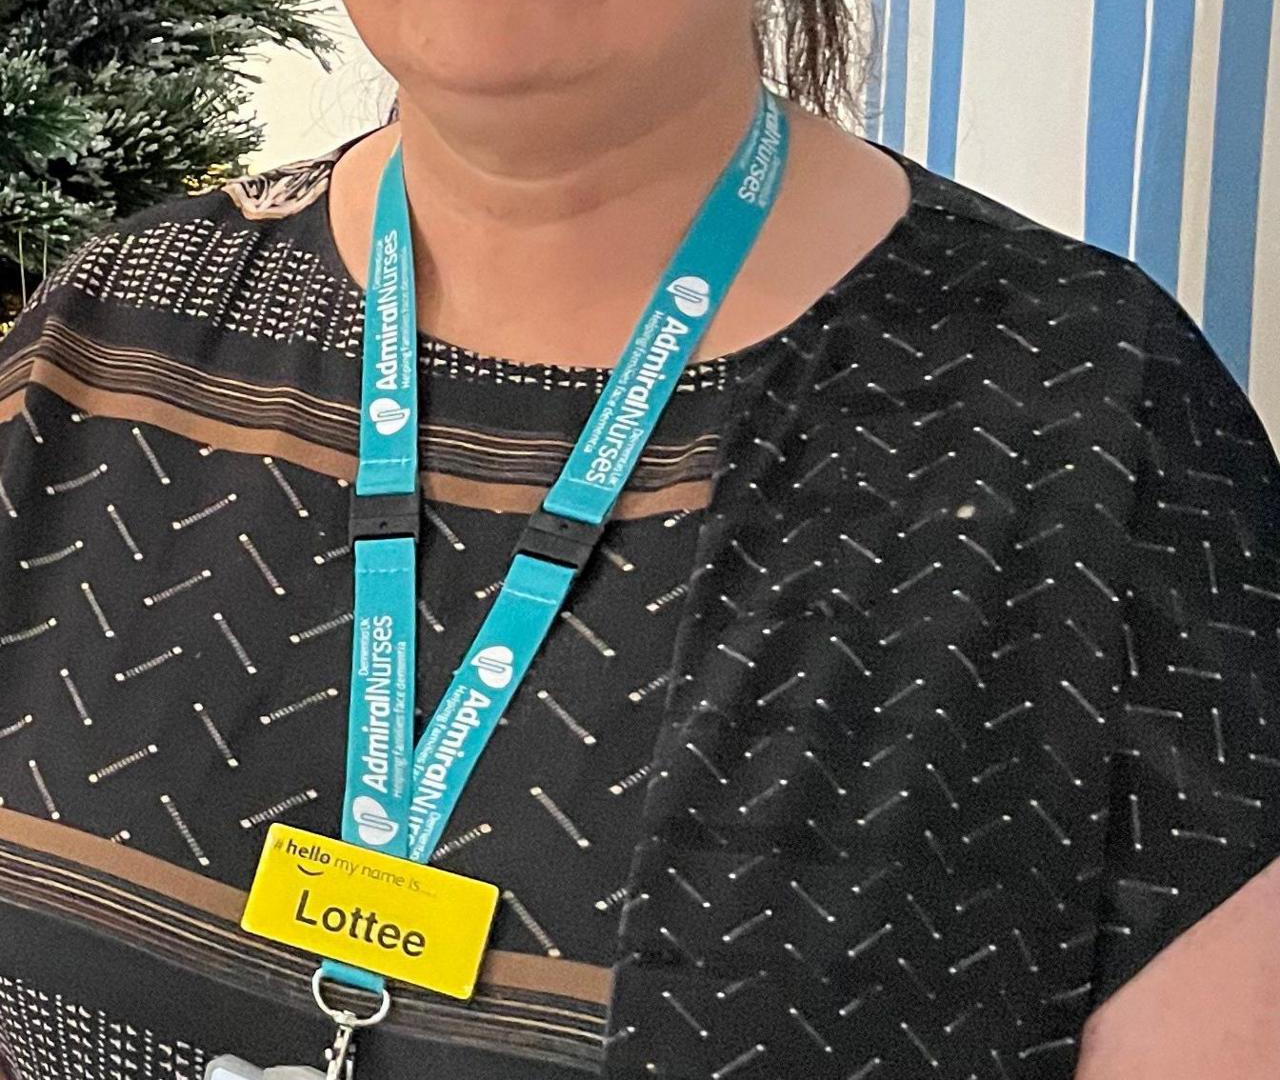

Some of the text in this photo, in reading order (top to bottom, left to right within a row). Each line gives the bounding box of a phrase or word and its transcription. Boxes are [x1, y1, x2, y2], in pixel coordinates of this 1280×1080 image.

[375, 229, 397, 390] AdmiralNurses
[584, 316, 689, 485] AdmiralNurses
[361, 615, 392, 793] AdmiralNurses
[295, 889, 427, 958] Lottee
[334, 856, 358, 875] my
[360, 865, 405, 887] name
